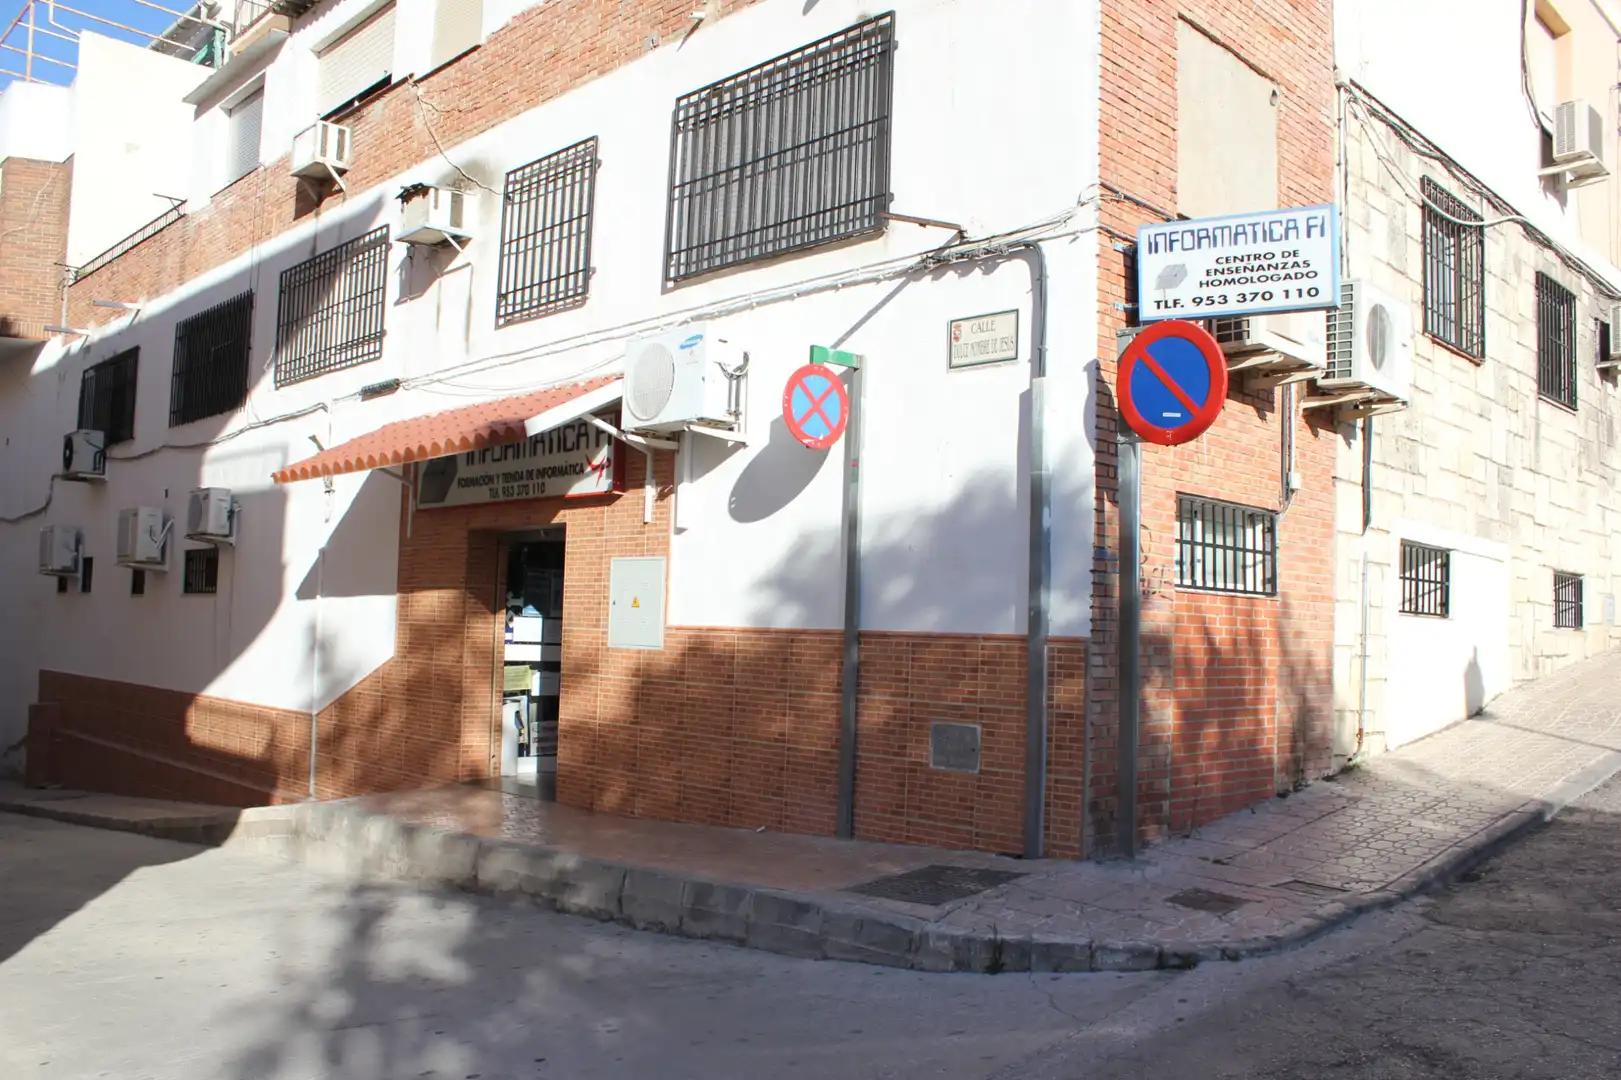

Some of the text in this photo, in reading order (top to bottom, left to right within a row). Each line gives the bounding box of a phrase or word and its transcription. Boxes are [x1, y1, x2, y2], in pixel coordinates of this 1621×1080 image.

[1148, 215, 1325, 255] INFORMATICA FI
[1215, 249, 1300, 265] CENTRO DE
[1205, 259, 1311, 277] ENSEÑANZAS
[1199, 270, 1319, 288] HOMOLOGADO
[1153, 286, 1320, 310] TLF. 953 370 110
[970, 319, 996, 334] CALLE
[526, 468, 535, 481] DE
[535, 461, 584, 480] INFORMÁTICA
[502, 485, 515, 498] 953
[516, 483, 529, 496] 370
[532, 482, 545, 494] 110
